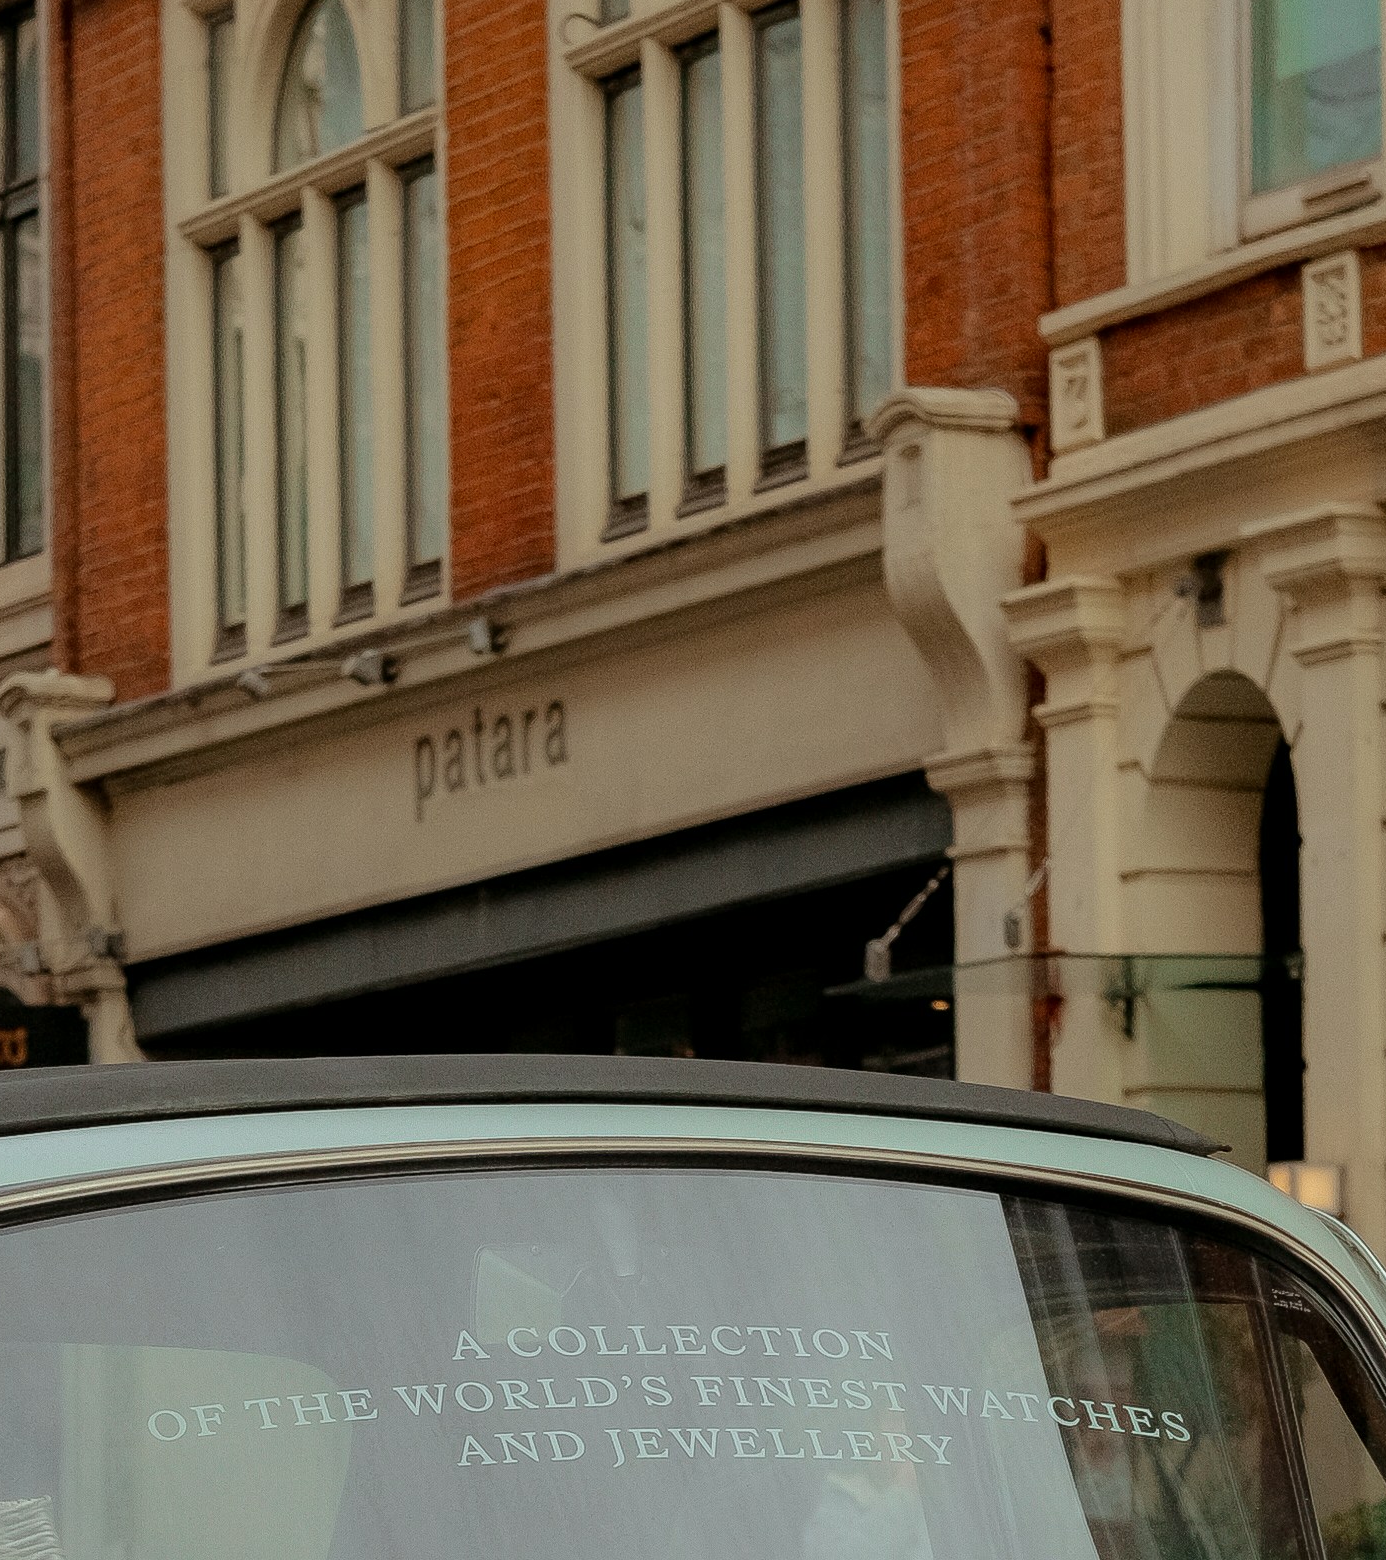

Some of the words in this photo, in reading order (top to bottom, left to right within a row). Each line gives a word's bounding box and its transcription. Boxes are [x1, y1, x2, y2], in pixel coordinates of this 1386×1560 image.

[414, 700, 568, 823] patara
[451, 1329, 491, 1361] A
[505, 1324, 895, 1362] COLLECTION
[147, 1403, 226, 1442] OF
[244, 1388, 380, 1431] THE
[393, 1375, 673, 1417] WORLD'S
[690, 1375, 907, 1413] FINEST
[921, 1383, 1193, 1443] WATCHES
[457, 1429, 586, 1468] AND
[611, 1426, 953, 1469] JEWELLERY
